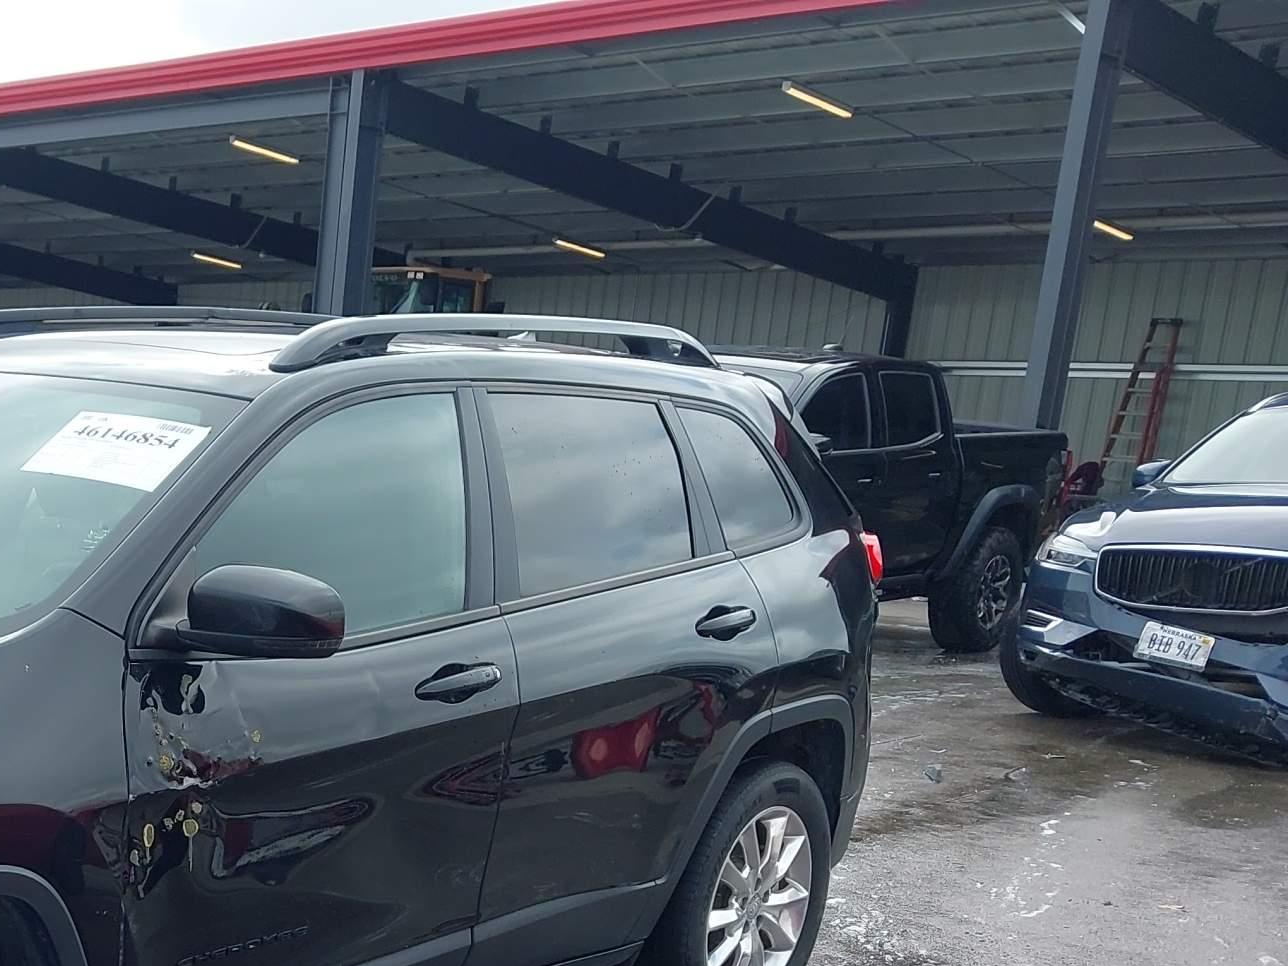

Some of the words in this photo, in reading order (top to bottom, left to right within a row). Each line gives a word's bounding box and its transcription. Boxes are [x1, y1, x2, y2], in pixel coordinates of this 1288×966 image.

[73, 425, 181, 449] 46146854
[1162, 628, 1197, 640] NEBRASKA
[1175, 640, 1202, 661] 947
